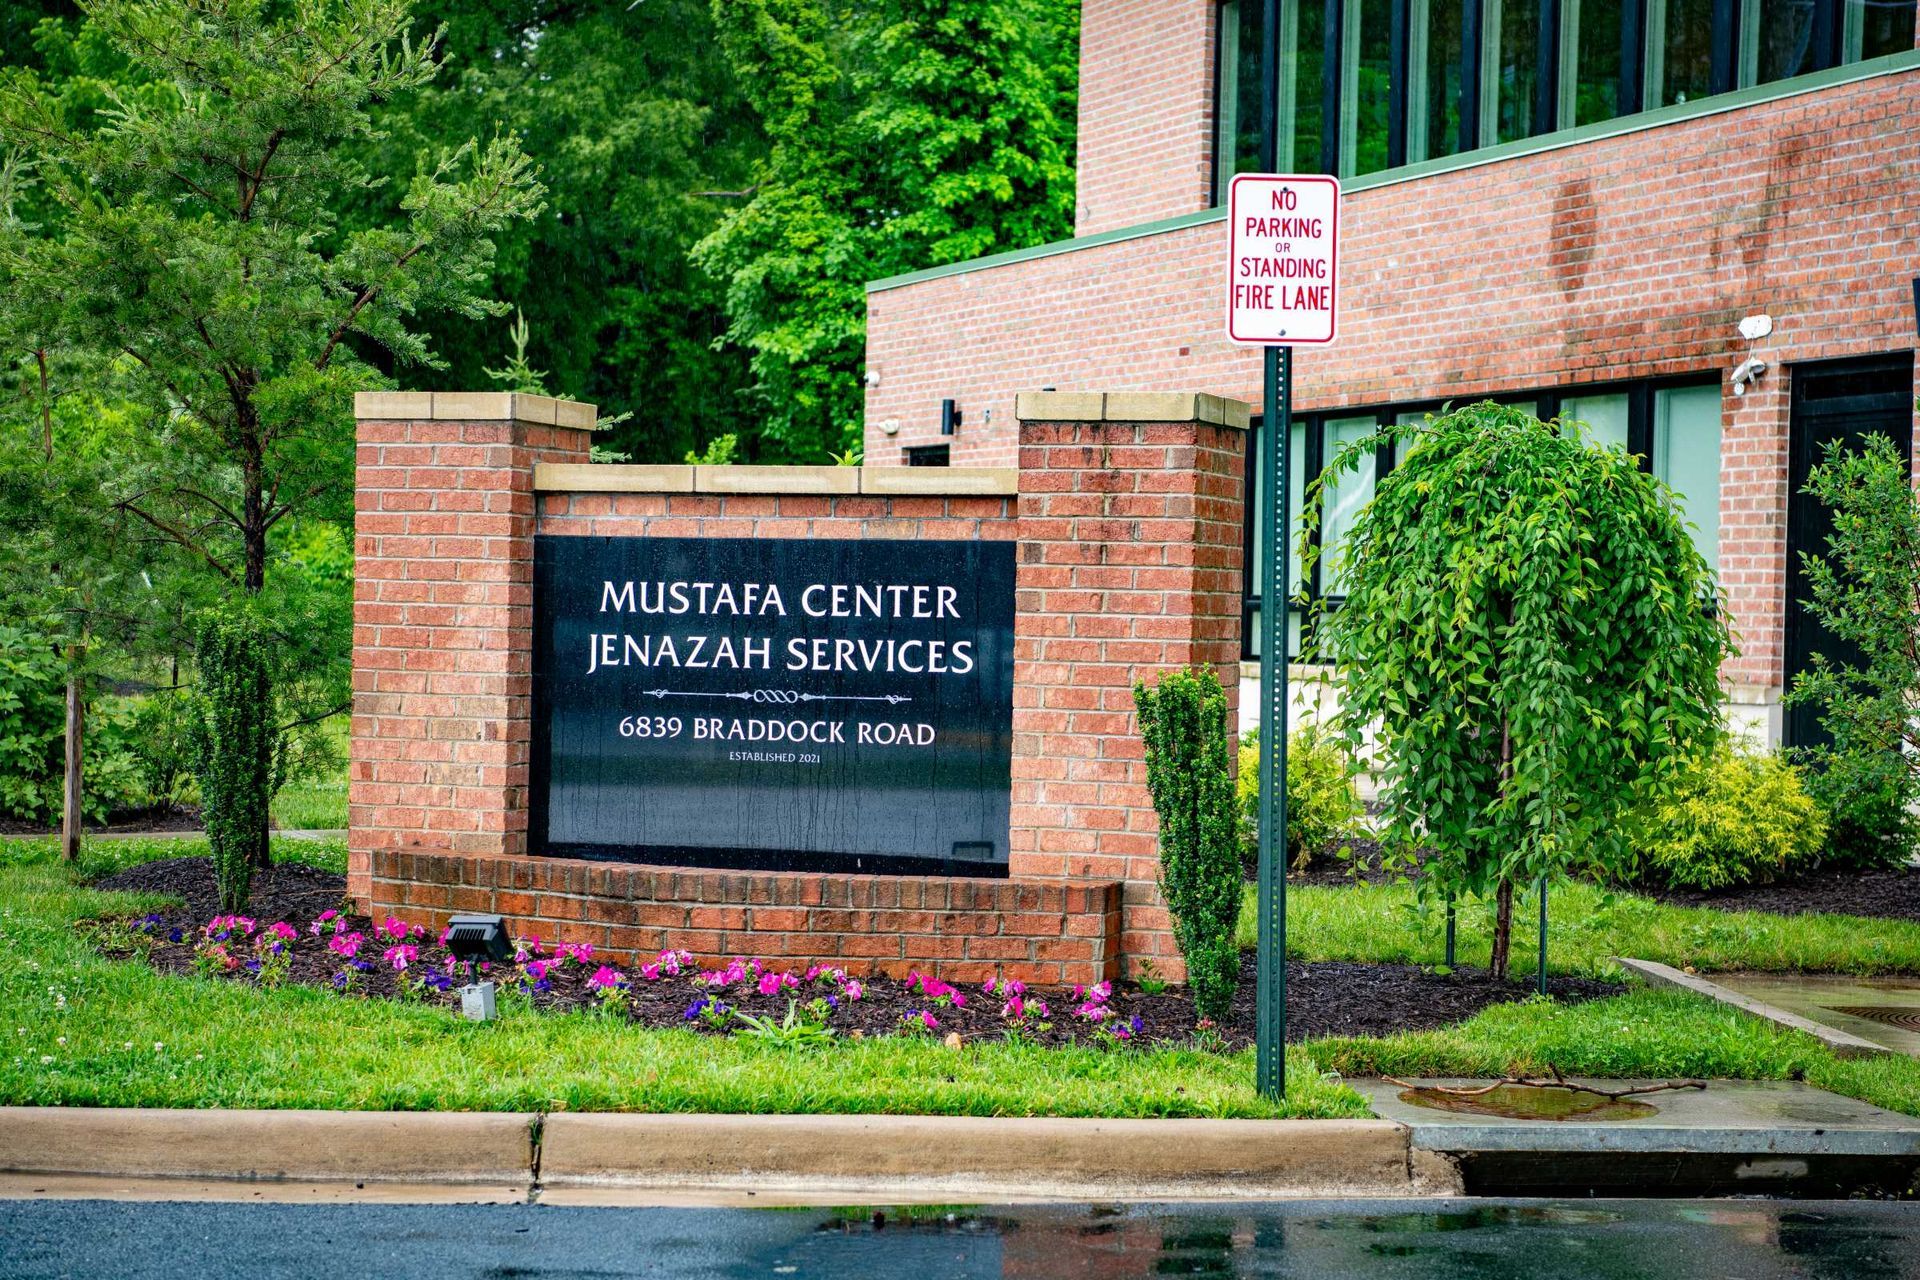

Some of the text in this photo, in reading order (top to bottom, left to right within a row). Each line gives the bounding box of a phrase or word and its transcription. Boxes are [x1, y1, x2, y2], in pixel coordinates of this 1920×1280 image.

[1271, 190, 1297, 211] NO
[1246, 217, 1321, 238] PARKING
[1275, 242, 1291, 253] OR
[1241, 257, 1326, 278] STANDING
[1236, 285, 1329, 310] FIRE LANE
[600, 582, 960, 617] MUSTAFA CENTER
[587, 634, 973, 674] JENAZAH SERVICES
[620, 717, 935, 745] 6839 BRADDOCK ROAD
[729, 752, 820, 764] ESTABLISHED 2021
